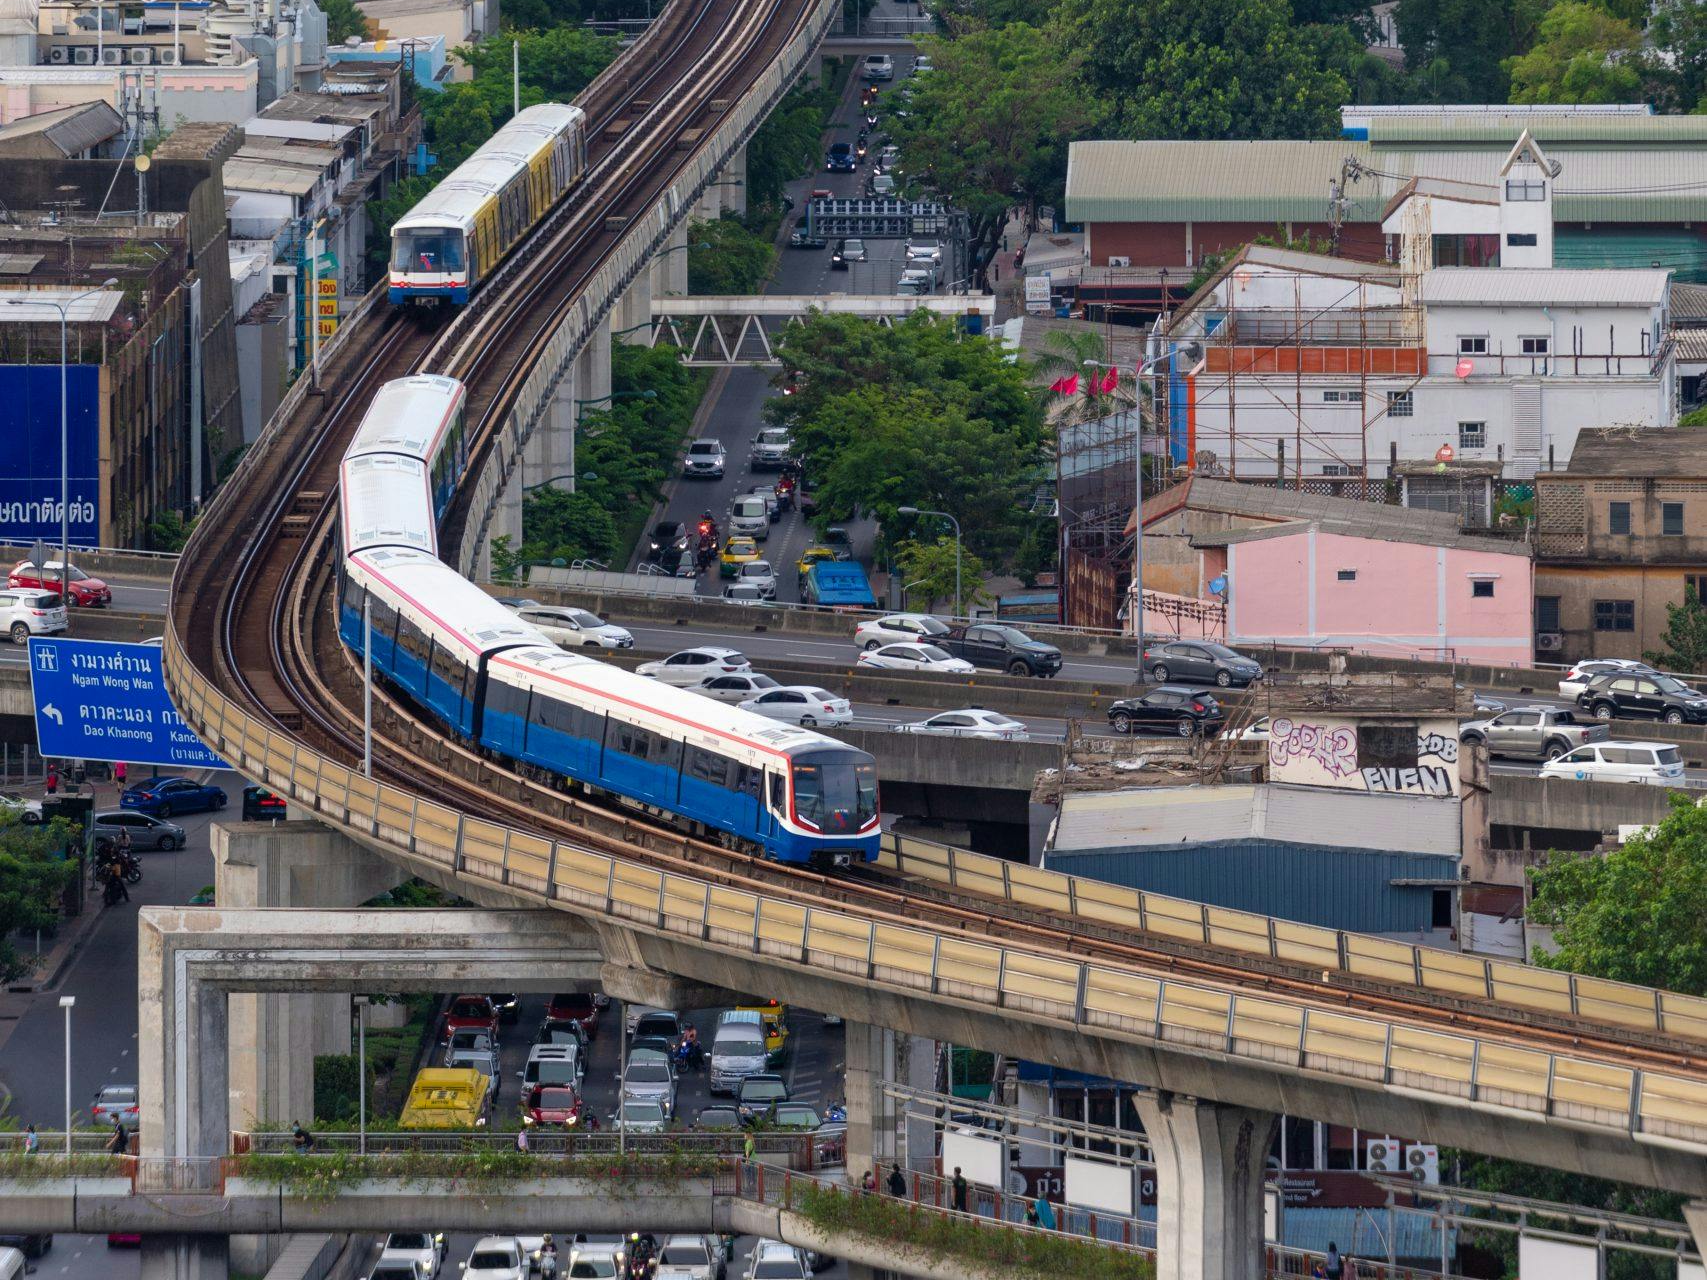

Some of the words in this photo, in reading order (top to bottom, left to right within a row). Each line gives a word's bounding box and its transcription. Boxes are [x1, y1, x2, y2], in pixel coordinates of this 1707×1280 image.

[71, 651, 152, 673] งามวงศ์วาน
[72, 674, 99, 688] Ngam
[102, 675, 130, 690] Wong
[133, 677, 153, 690] Wan
[80, 704, 153, 723] ดาวคะนอง
[84, 725, 104, 737] Dao
[107, 726, 153, 742] Khanong
[1361, 765, 1452, 797] EVEN
